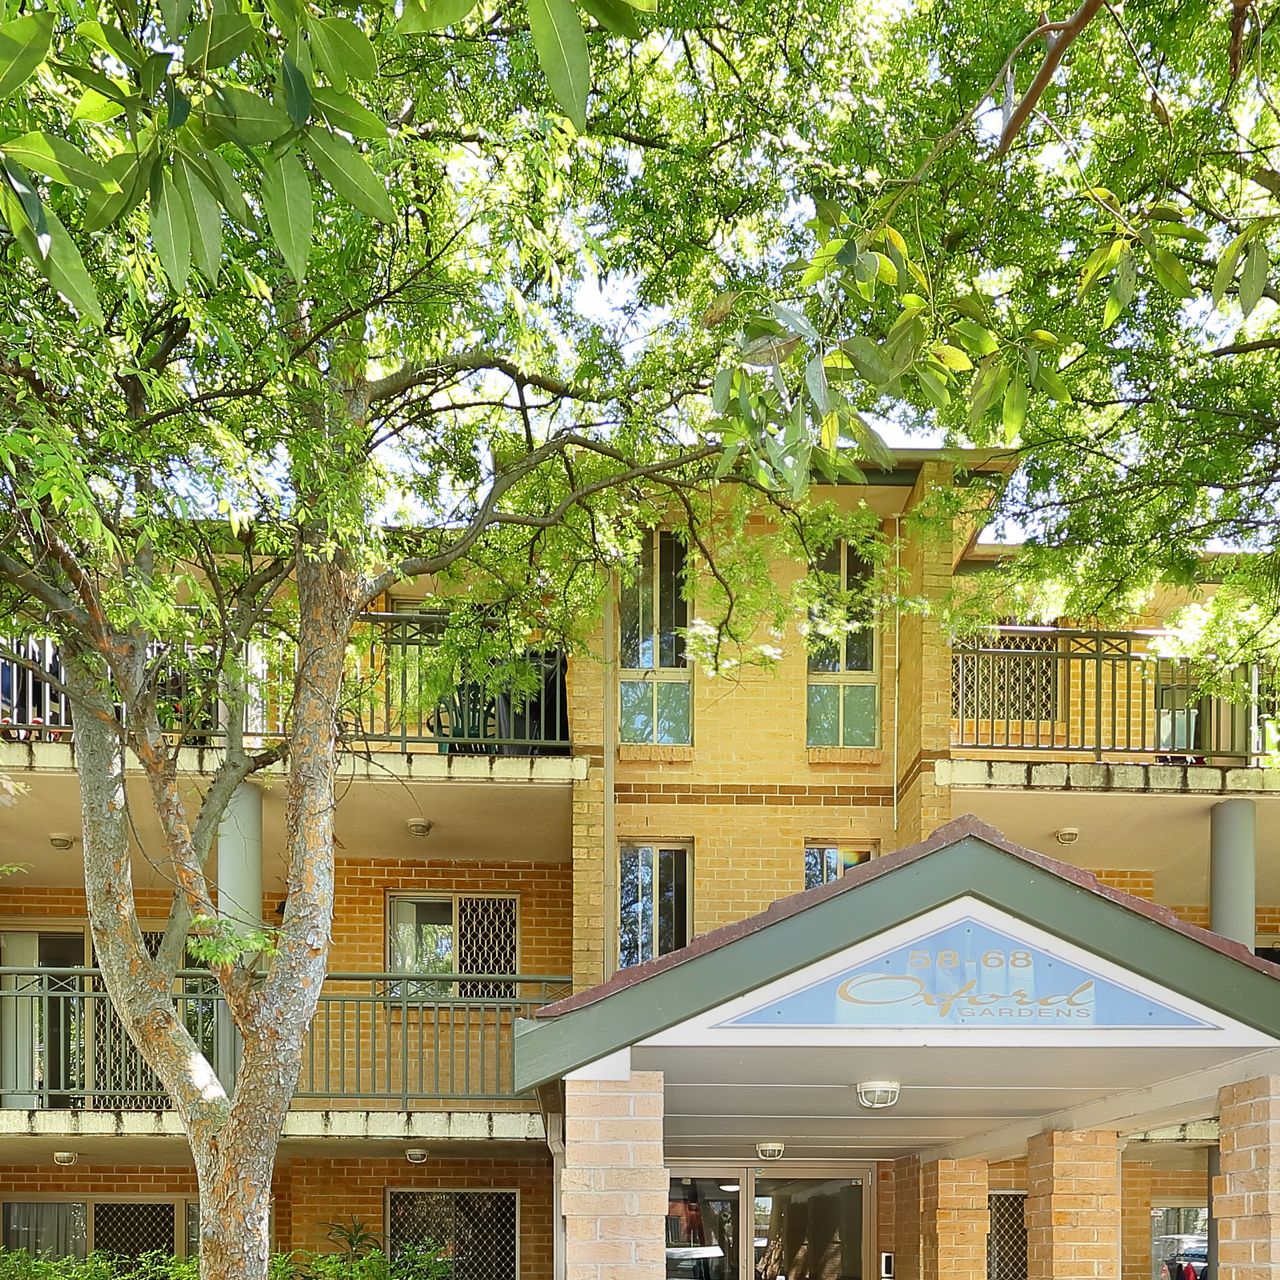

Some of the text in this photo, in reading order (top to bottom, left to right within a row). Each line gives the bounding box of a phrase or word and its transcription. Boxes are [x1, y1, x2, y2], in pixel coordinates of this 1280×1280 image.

[908, 950, 1033, 968] 58-68
[837, 973, 1095, 1017] Oxford
[957, 1007, 1091, 1018] GARDENS
